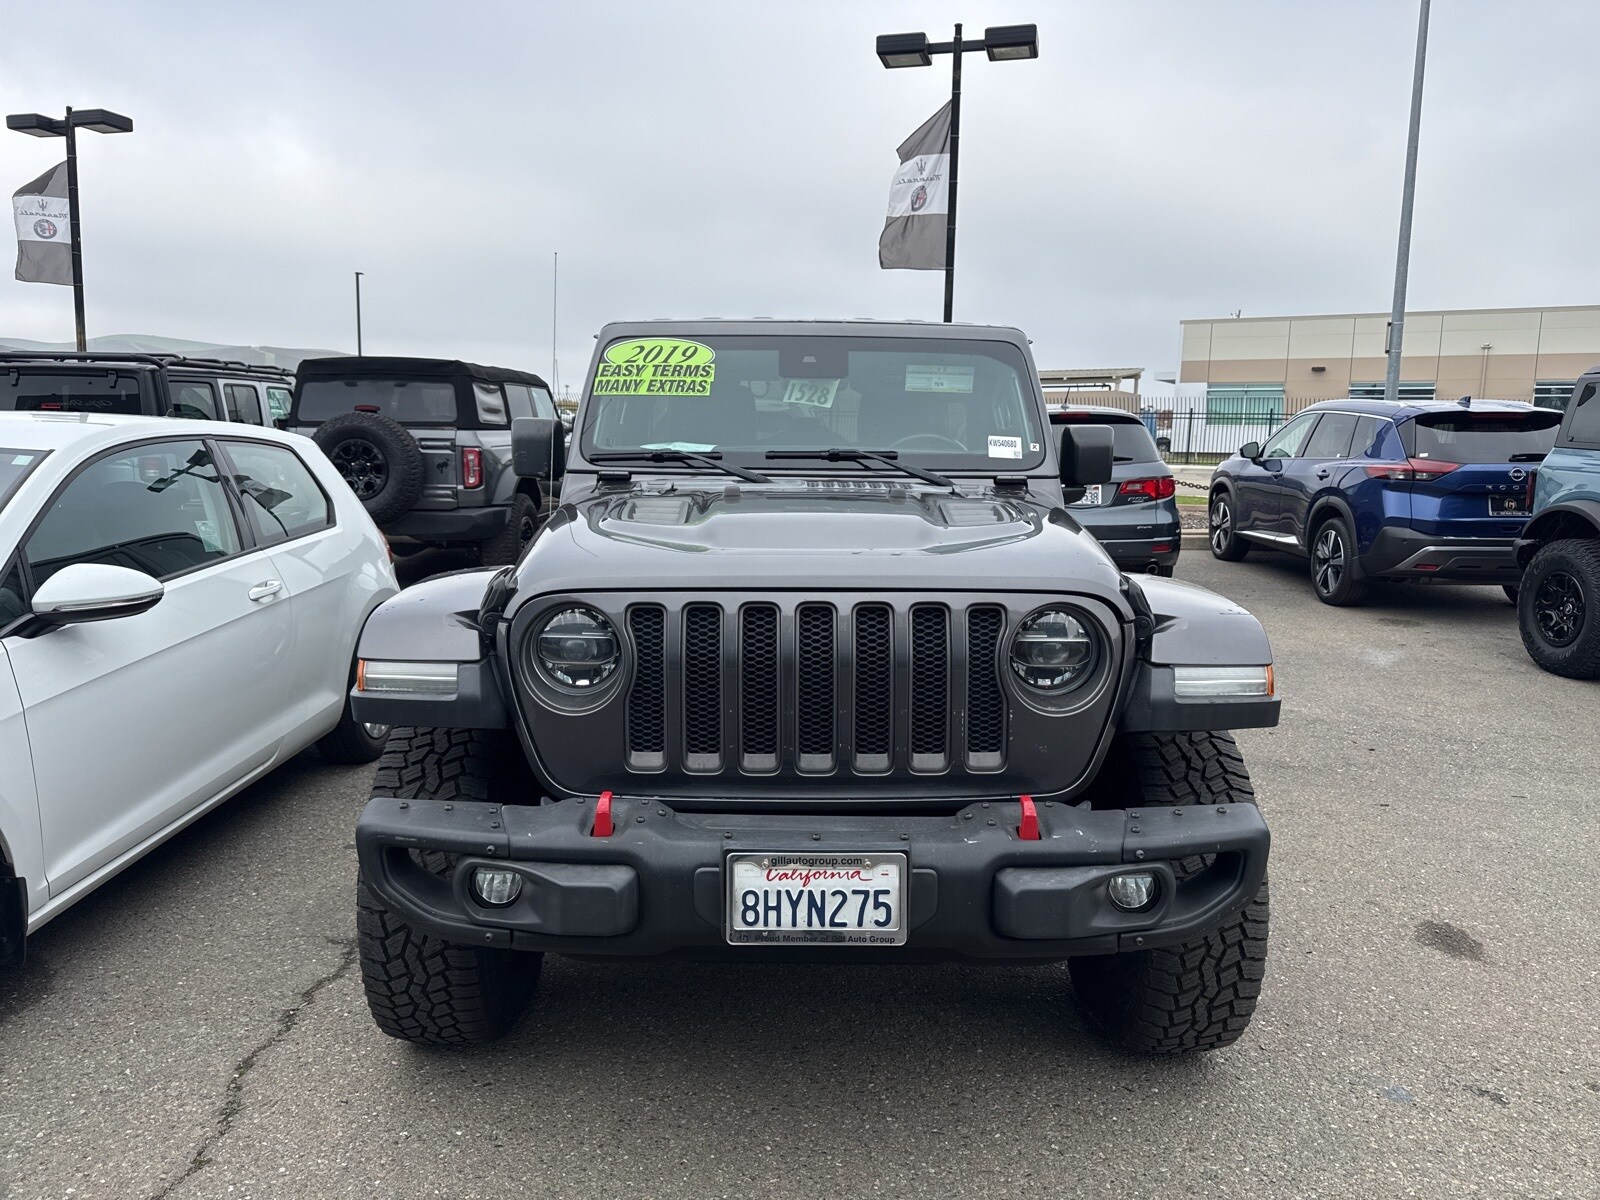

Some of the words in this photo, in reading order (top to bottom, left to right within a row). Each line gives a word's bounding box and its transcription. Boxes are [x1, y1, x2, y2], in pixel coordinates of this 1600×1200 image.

[620, 345, 699, 364] 2019
[600, 364, 648, 378] EASY
[651, 364, 713, 378] TERMS
[595, 379, 646, 393] MANY
[646, 379, 709, 393] EXTRAS
[786, 382, 830, 406] 1528
[770, 856, 863, 867] gillautogroup.com
[766, 868, 873, 887] California
[741, 888, 892, 928] 8HYN275
[783, 935, 818, 943] Member
[869, 936, 896, 945] Group
